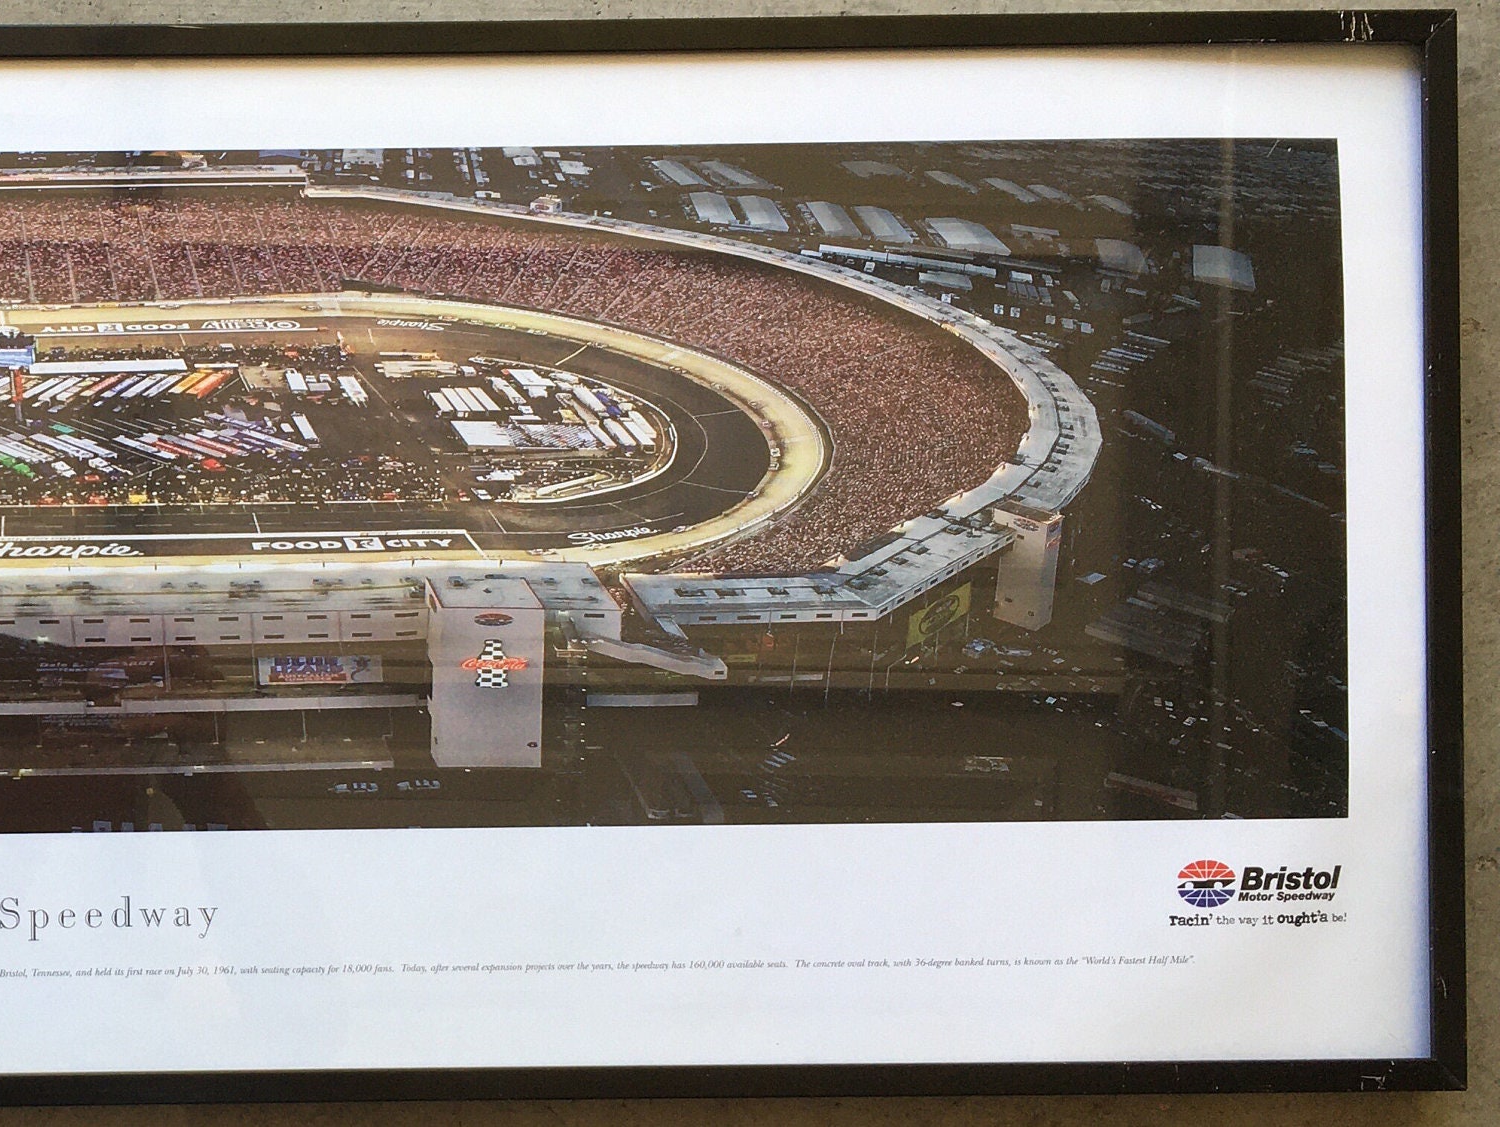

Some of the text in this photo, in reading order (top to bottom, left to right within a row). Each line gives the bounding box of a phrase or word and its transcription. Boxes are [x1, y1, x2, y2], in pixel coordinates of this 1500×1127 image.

[126, 323, 190, 331] FOOD
[251, 538, 453, 551] FOOD CITY
[1240, 865, 1342, 891] Bristol
[1238, 891, 1335, 903] Motor Speedway
[1169, 910, 1348, 927] racin' the way it ought'a be!
[75, 968, 93, 976] and
[94, 967, 112, 976] held
[114, 967, 124, 976] its
[125, 967, 143, 978] first
[175, 966, 193, 978] July
[240, 965, 258, 974] with
[261, 966, 291, 976] seating
[291, 965, 325, 976] capacity
[326, 964, 340, 975] for
[430, 963, 449, 975] after
[451, 962, 480, 971] several
[480, 962, 523, 974] expansion
[524, 962, 555, 973] projects
[557, 963, 575, 971] over
[576, 961, 589, 970] the
[616, 960, 630, 969] the
[631, 960, 669, 972] speedway
[671, 960, 686, 969] has
[726, 959, 765, 968] available
[794, 959, 811, 968] The
[812, 959, 845, 967] concrete
[846, 958, 866, 967] oval
[893, 958, 912, 967] with
[915, 957, 953, 969] 36-degree
[954, 956, 984, 966] banked
[1023, 956, 1052, 965] known
[1065, 956, 1079, 965] the
[1118, 955, 1146, 965] Fastest
[1148, 955, 1170, 966] Half
